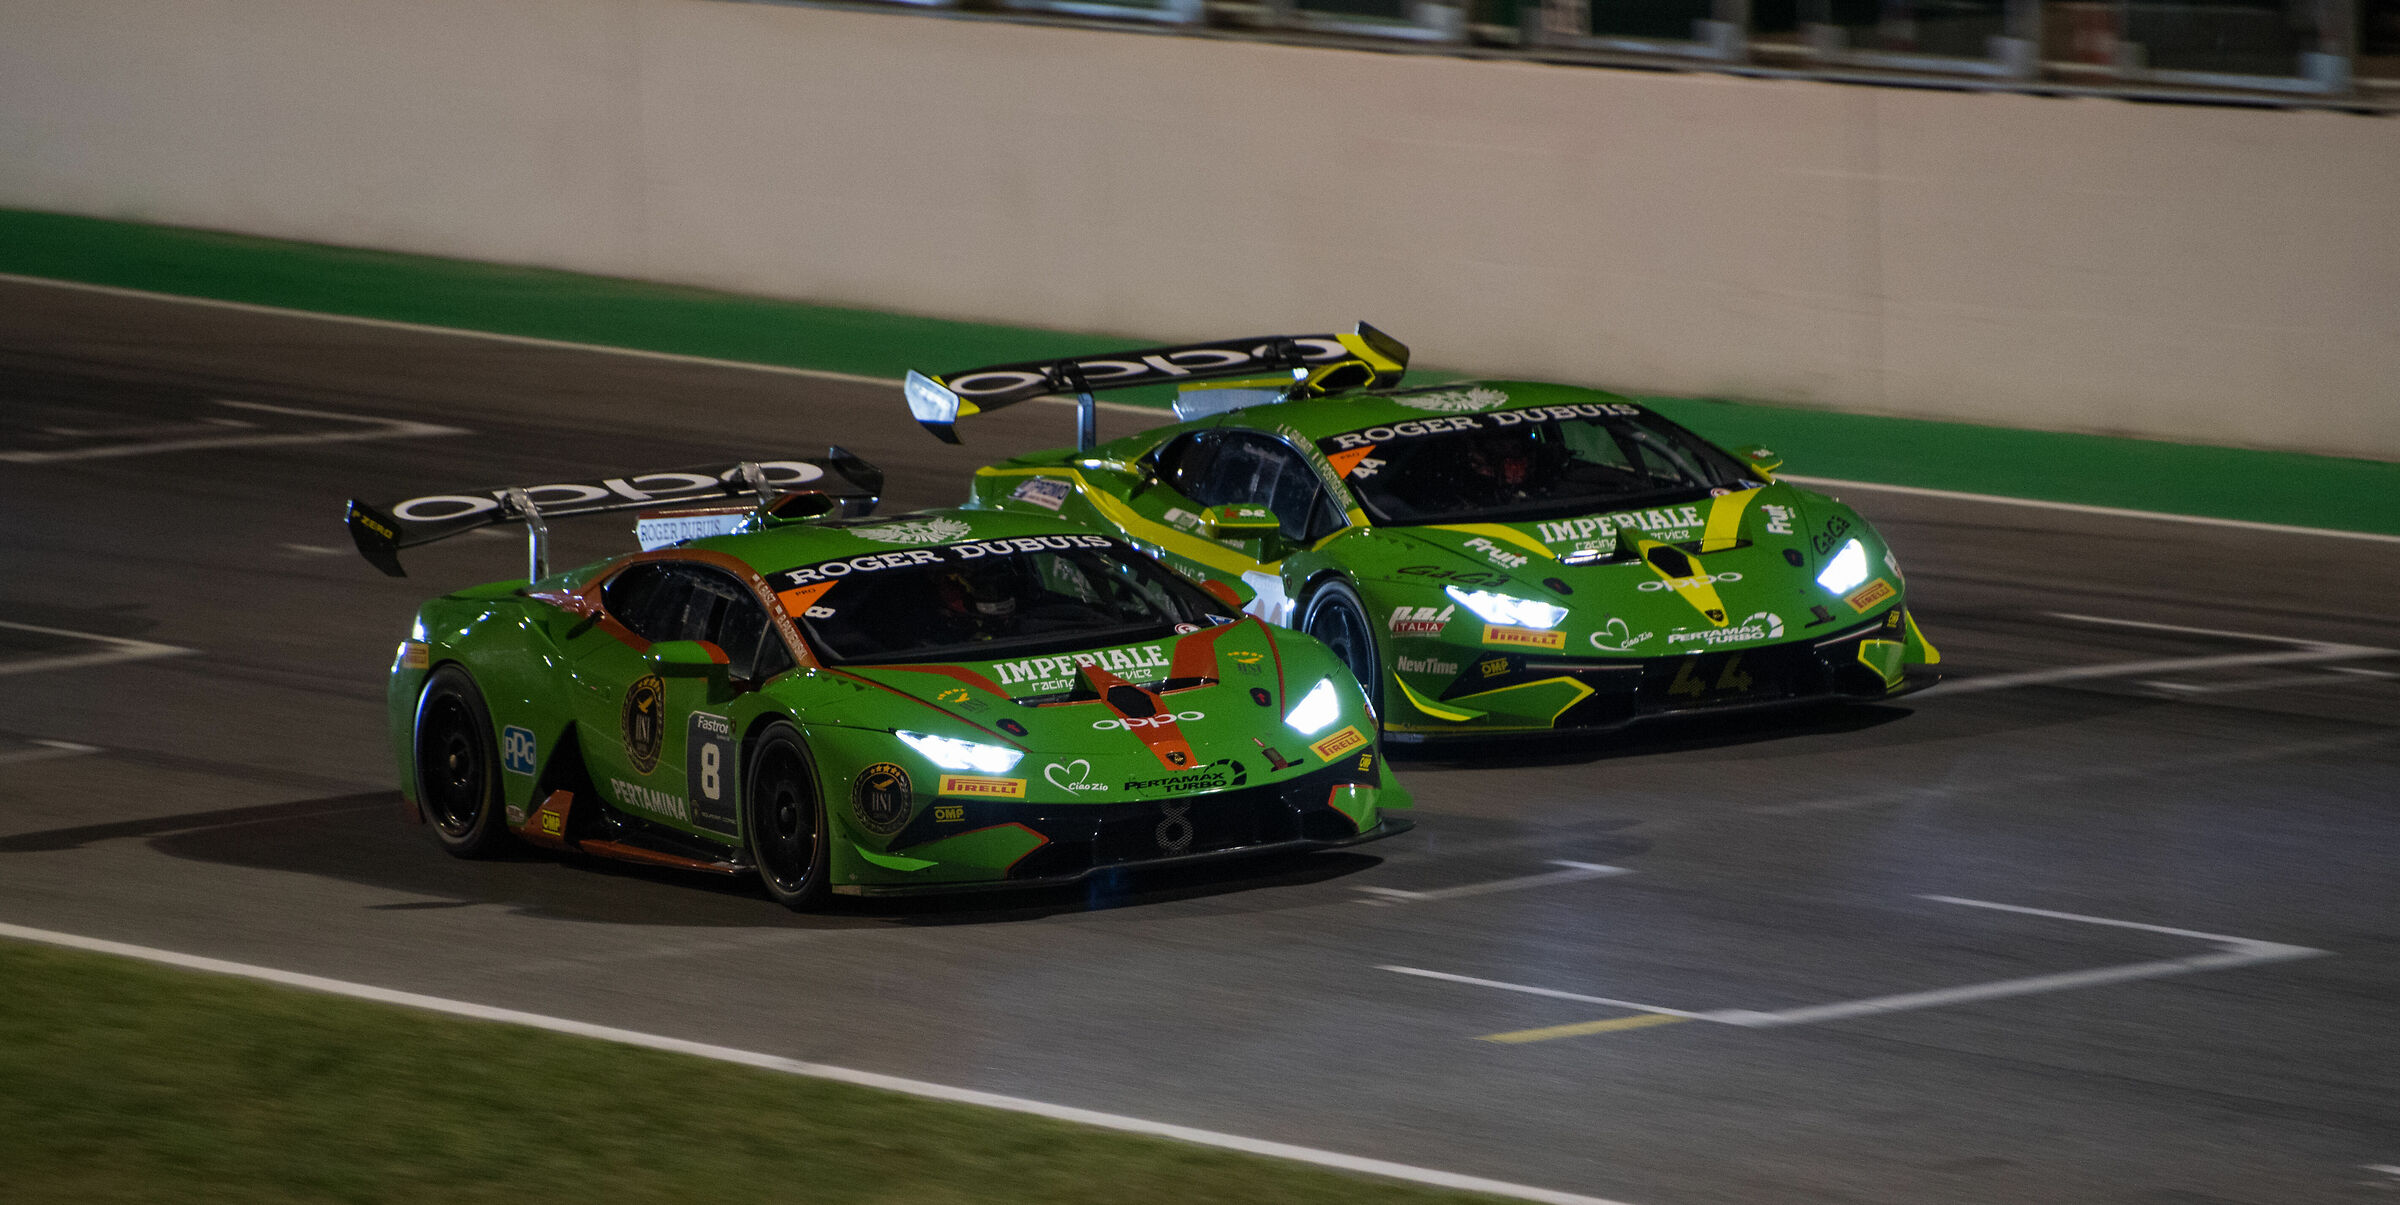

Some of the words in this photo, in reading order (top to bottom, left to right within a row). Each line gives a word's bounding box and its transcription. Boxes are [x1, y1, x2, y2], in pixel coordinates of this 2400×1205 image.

[948, 338, 1350, 397] oppo
[1332, 416, 1483, 450] ROGER
[1487, 403, 1640, 427] DUBUIS
[1351, 457, 1387, 479] 44
[392, 460, 824, 521] oppo
[641, 522, 678, 542] ROGER
[680, 519, 721, 540] DUBUIS
[1537, 507, 1704, 544] IMPERIALE
[785, 548, 945, 586] ROGER
[949, 535, 1112, 560] DUBUIS
[1637, 571, 1743, 592] oppo
[1851, 582, 1891, 609] PIRELLI
[804, 605, 837, 619] 8
[1395, 622, 1440, 632] ITALIA
[1490, 627, 1560, 646] PIRELLI
[1668, 624, 1763, 645] PERTAMAX
[1620, 637, 1639, 649] Ciao
[1638, 631, 1654, 643] Zio
[1707, 632, 1766, 645] TURBO
[993, 644, 1170, 685] IMPERIALE
[1480, 660, 1510, 676] OMP
[1092, 711, 1205, 731] oppo
[505, 732, 535, 768] PPG
[1317, 729, 1363, 757] PIRELLI
[701, 742, 720, 801] 8
[1124, 772, 1225, 791] PERTAMAX
[947, 778, 1018, 795] PIRELLI
[1068, 781, 1091, 792] Ciao
[1092, 782, 1109, 792] Zio
[1165, 779, 1227, 792] TURBO
[610, 777, 689, 822] PERTAMINA
[542, 813, 562, 832] OMP
[935, 807, 965, 821] OMP
